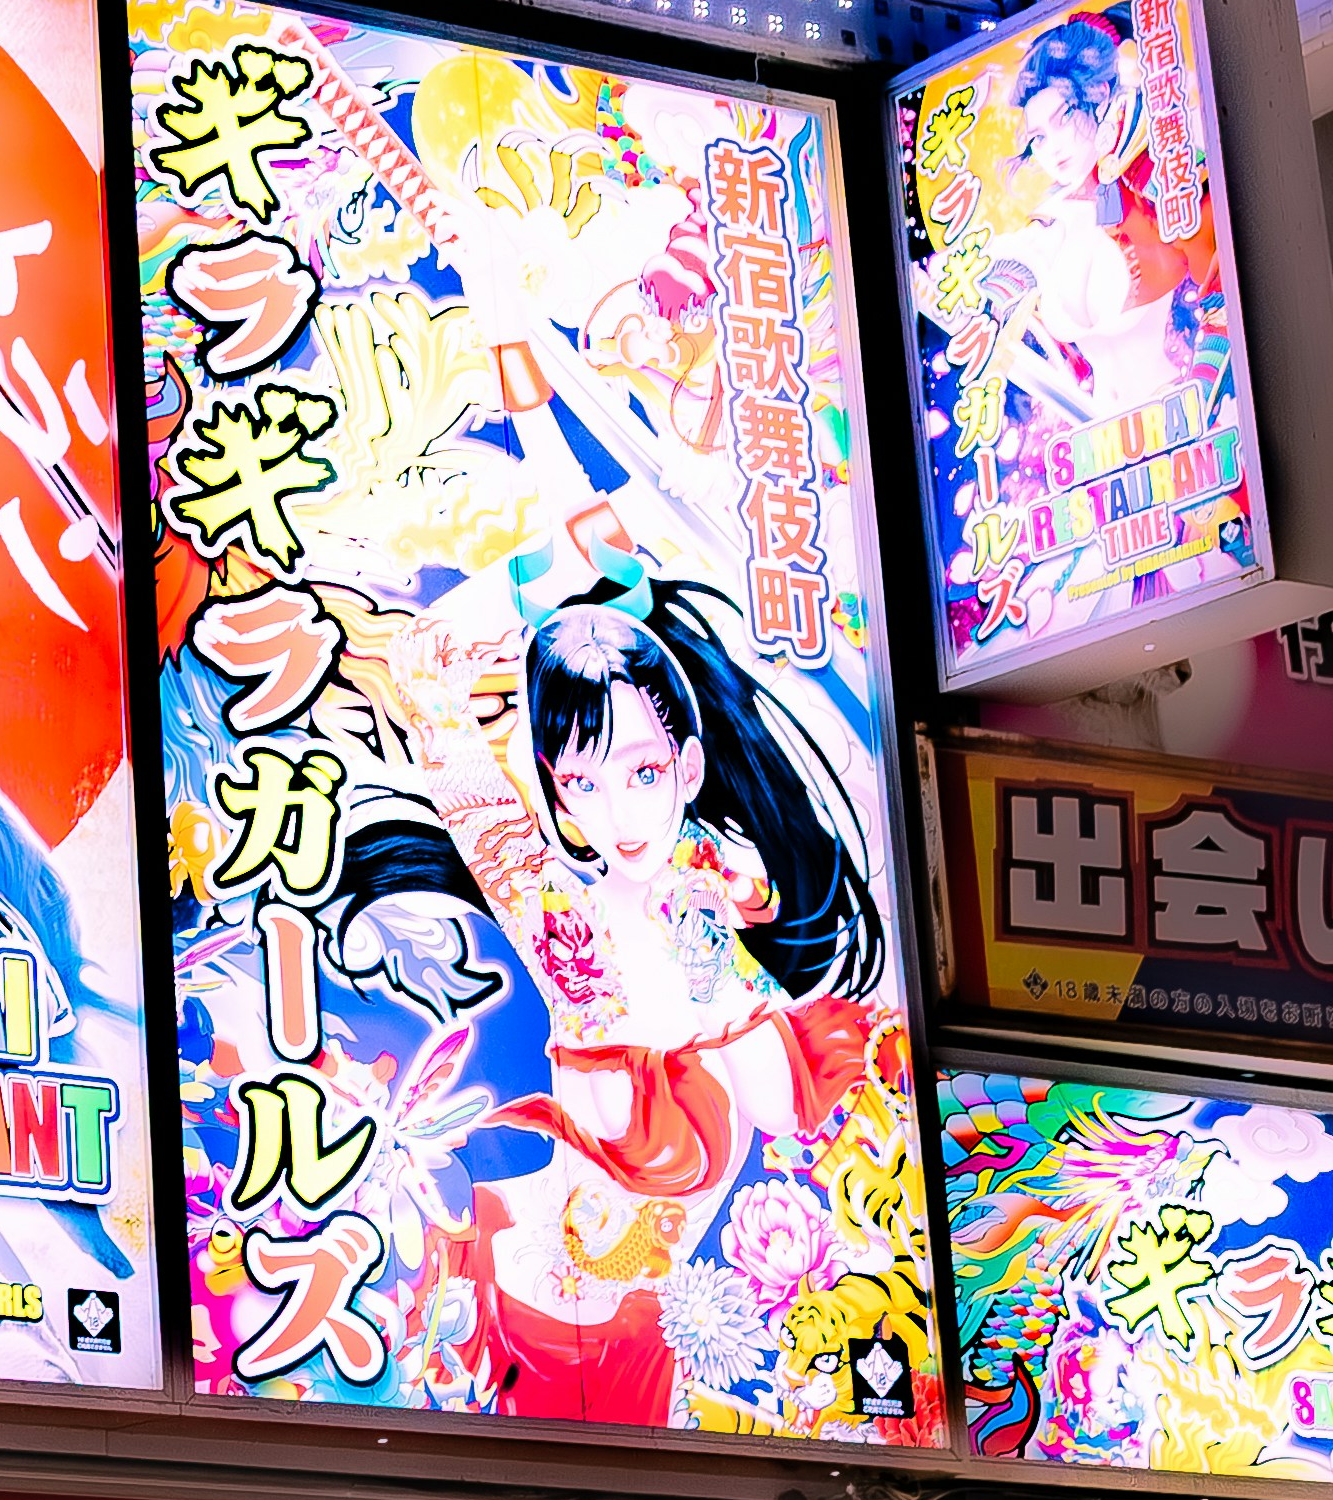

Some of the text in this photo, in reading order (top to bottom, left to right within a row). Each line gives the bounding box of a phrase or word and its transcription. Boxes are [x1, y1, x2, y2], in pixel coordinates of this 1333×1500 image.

[705, 138, 832, 664] 新宿歌舞伎町
[918, 83, 1027, 641] ギラギラガールズ
[1028, 430, 1242, 561] RESTAURANT
[1047, 382, 1203, 489] SAMURAI
[1102, 501, 1172, 569] TIME
[147, 44, 390, 1391] ギラギラガールズ
